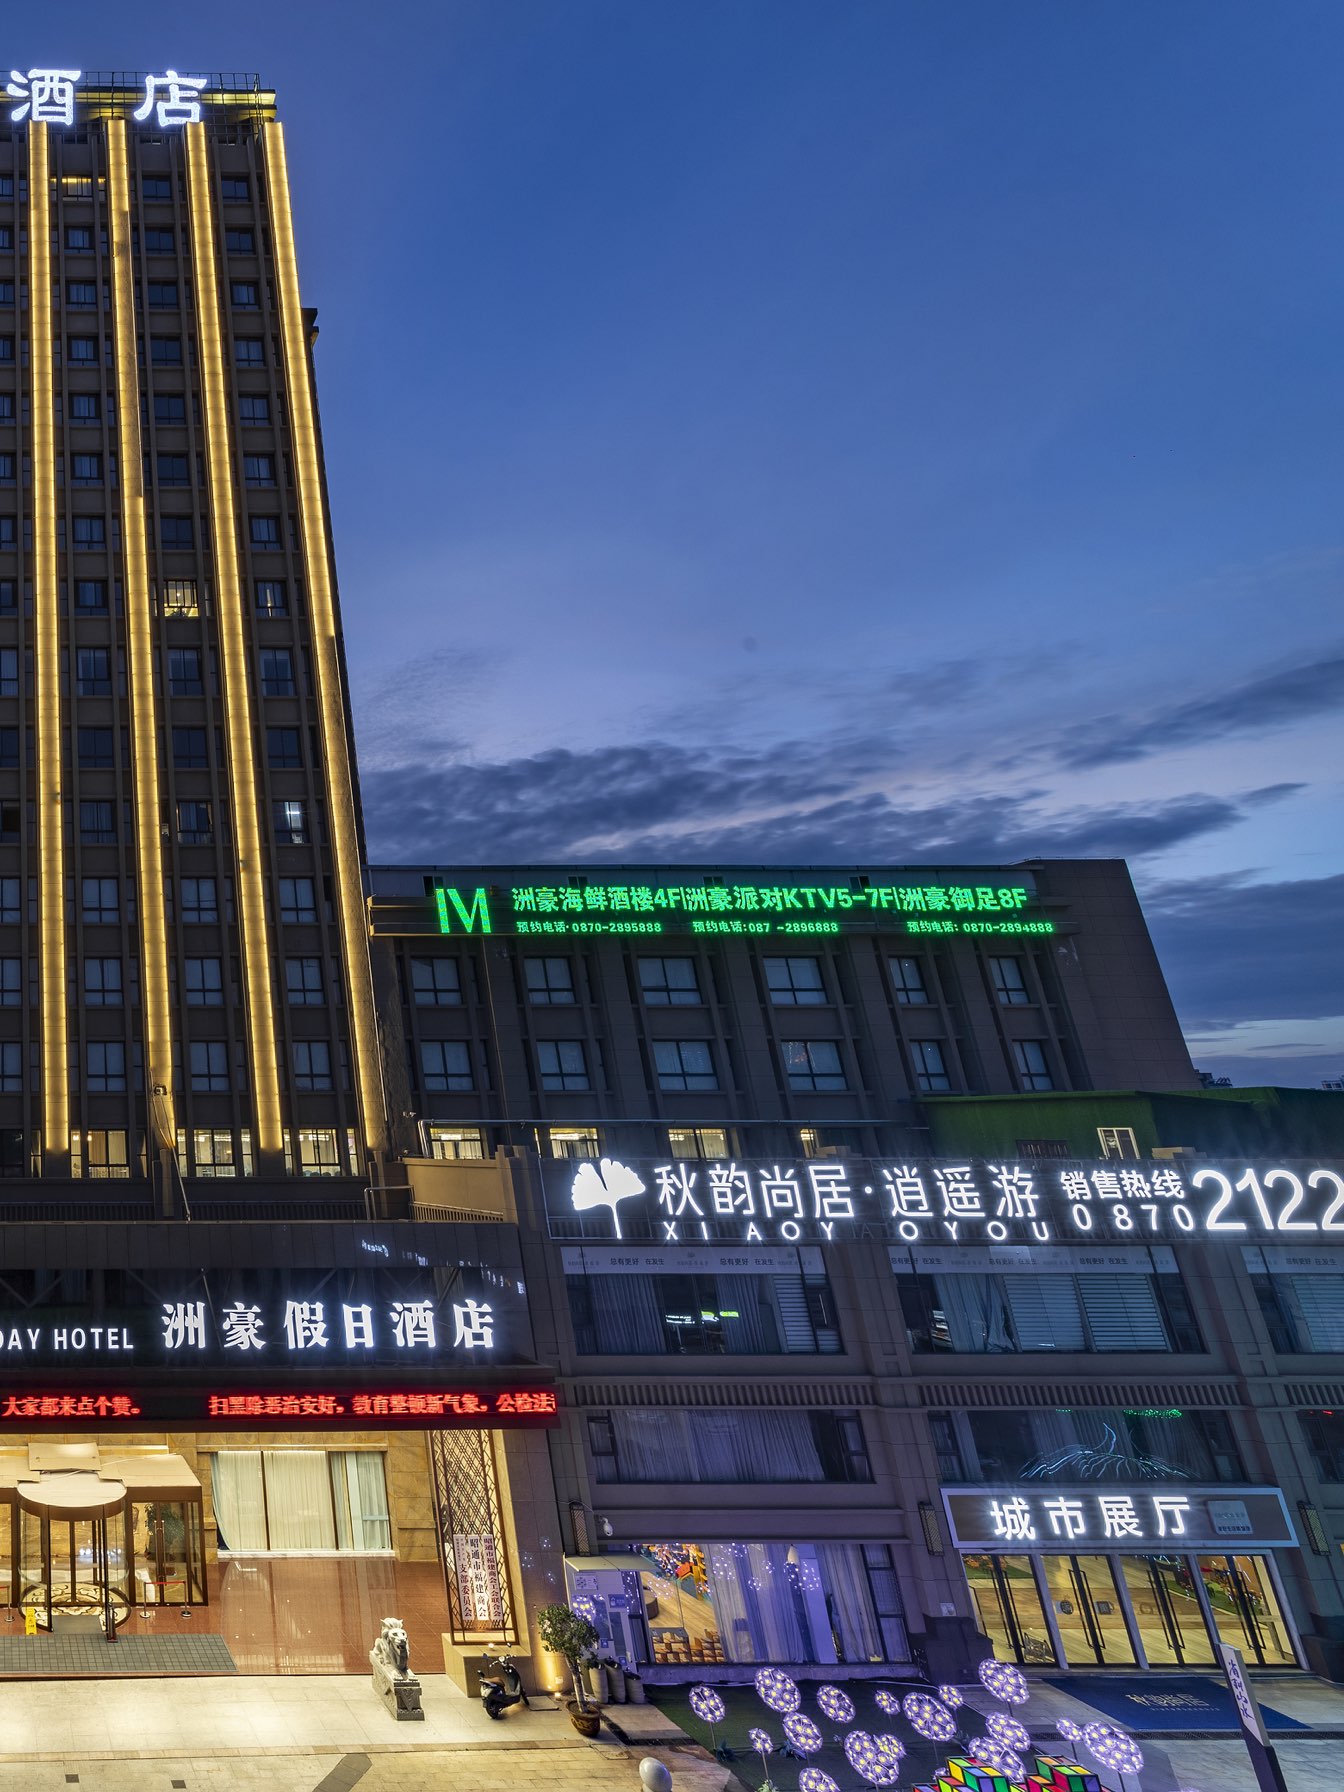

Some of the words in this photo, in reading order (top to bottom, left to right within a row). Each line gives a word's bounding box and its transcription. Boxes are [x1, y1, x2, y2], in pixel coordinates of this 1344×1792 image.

[1059, 1169, 1185, 1201] 销售热线
[54, 1327, 135, 1350] HOTEL
[161, 1298, 495, 1350] 洲豪假日酒店
[990, 1495, 1191, 1540] 城市展厅
